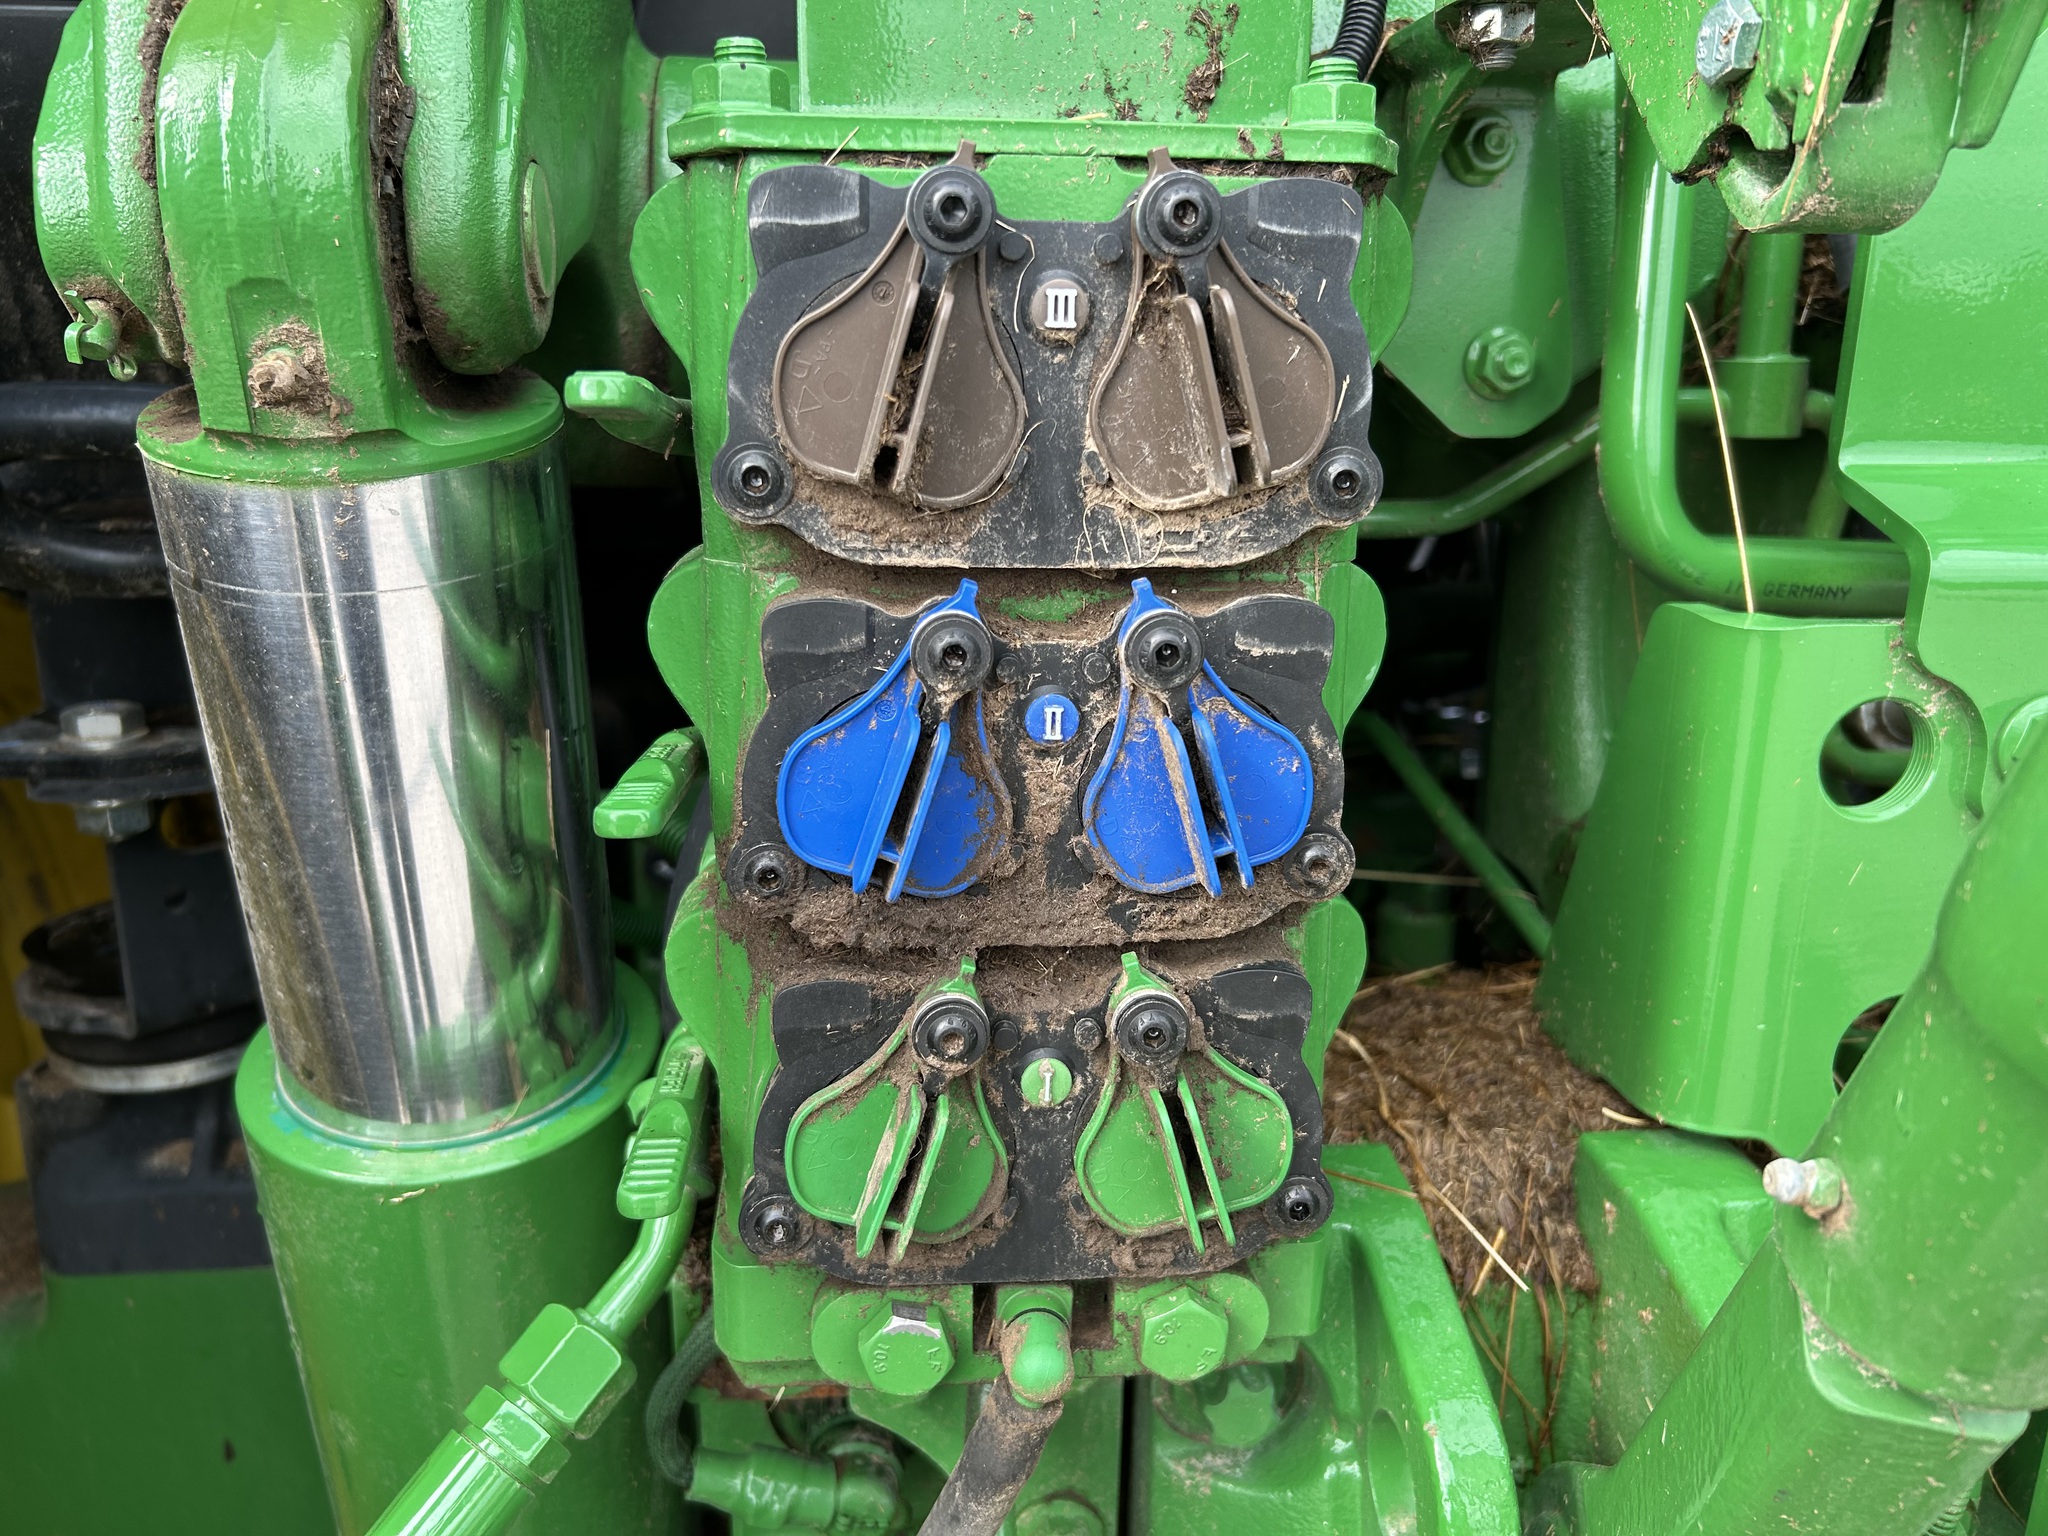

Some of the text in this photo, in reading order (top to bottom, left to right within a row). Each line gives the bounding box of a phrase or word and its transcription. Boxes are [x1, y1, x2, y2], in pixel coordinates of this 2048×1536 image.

[1044, 288, 1078, 329] III
[1762, 582, 1852, 600] GERMANY
[1042, 705, 1065, 741] II
[1043, 1071, 1054, 1102] I
